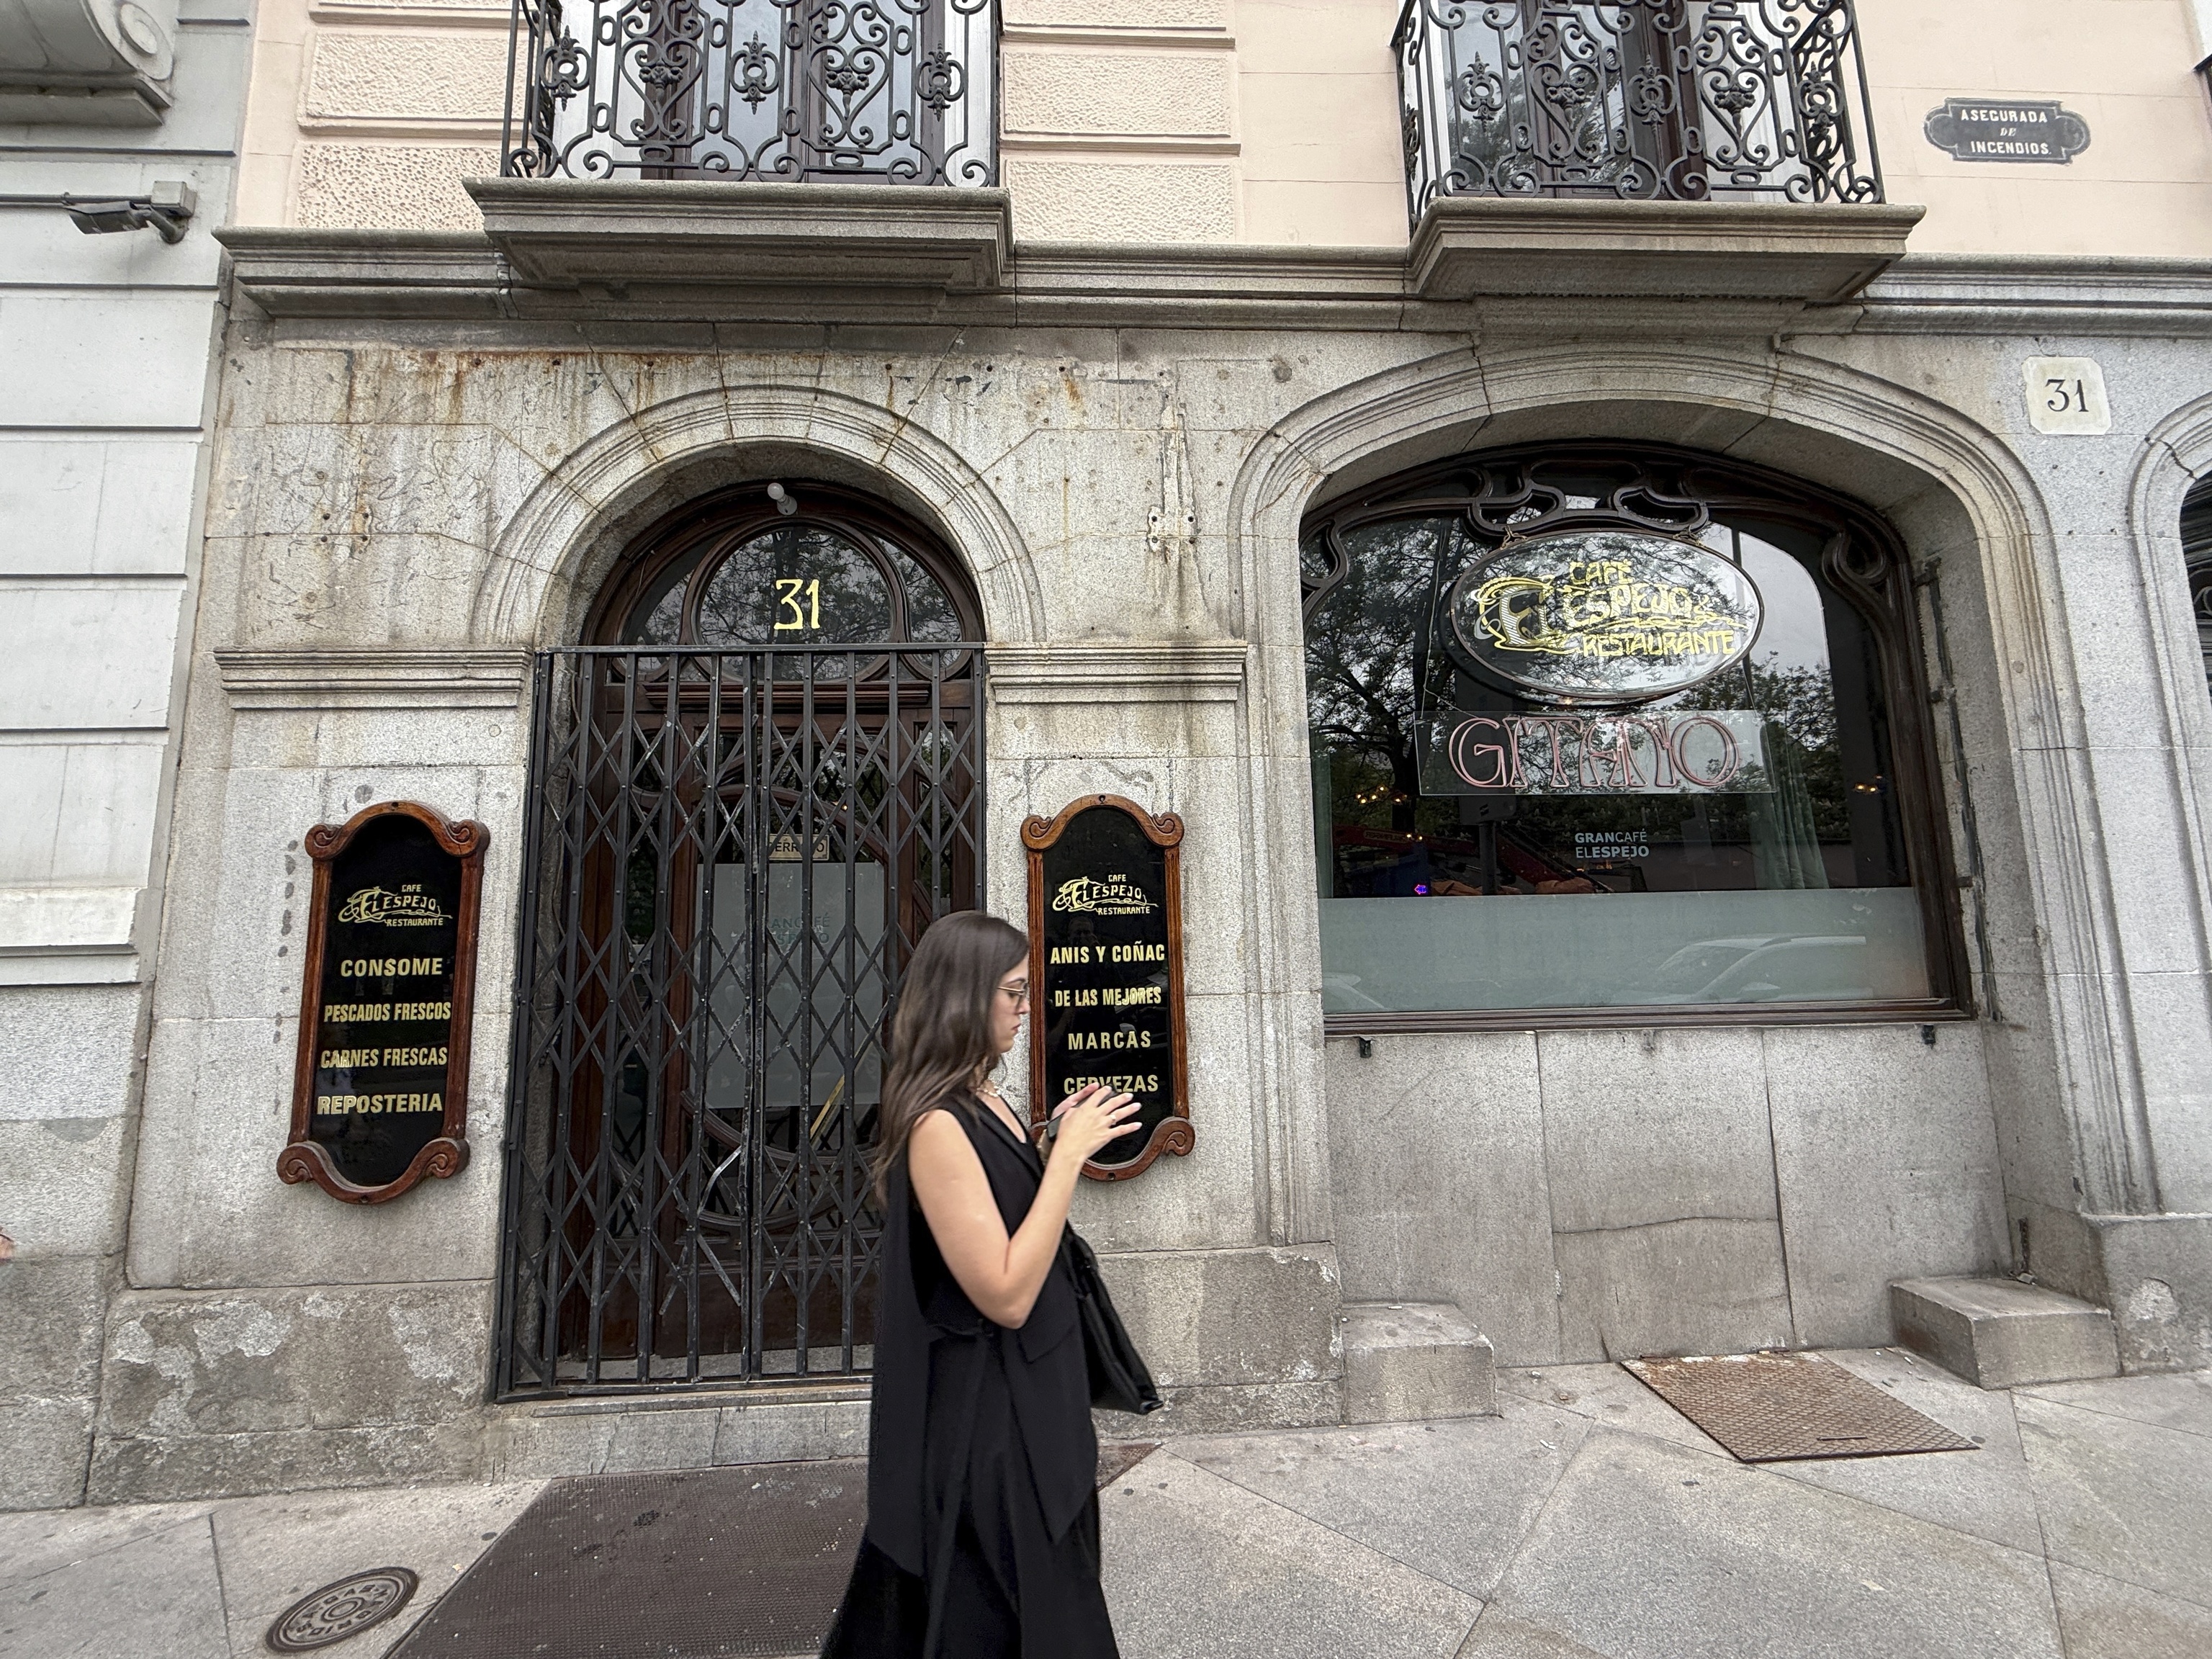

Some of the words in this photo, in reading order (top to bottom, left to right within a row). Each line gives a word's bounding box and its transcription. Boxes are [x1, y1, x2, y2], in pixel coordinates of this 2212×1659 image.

[1961, 109, 2048, 123] ASEGURADA
[2000, 127, 2016, 137] DE
[2045, 379, 2090, 413] 31
[773, 579, 821, 630] 31
[1563, 583, 1692, 630] ESPEJO
[1583, 630, 1736, 657] RESTAURANTE
[1449, 716, 1740, 788] GITANO
[768, 842, 824, 853] ERRO
[1092, 885, 1142, 899] ESPEJO
[382, 895, 436, 911] ESPEJO
[1097, 907, 1151, 915] RESTAURANTE
[385, 918, 444, 927] RESTAURANTE
[1050, 946, 1090, 964] ANIS
[1095, 945, 1107, 963] Y
[1112, 940, 1165, 963] COÑAC
[341, 958, 444, 977] CONSOME
[1055, 989, 1071, 1007] DE
[1074, 989, 1098, 1007] LAS
[1102, 986, 1162, 1006] MEJORES
[323, 1003, 391, 1023] PESCADOS
[393, 1002, 452, 1021] FRESCOS
[1068, 1030, 1151, 1051] MARCAS
[320, 1048, 379, 1069] CARNES
[382, 1047, 448, 1066] FRESCAS
[316, 1092, 444, 1115] REPOSTERIA
